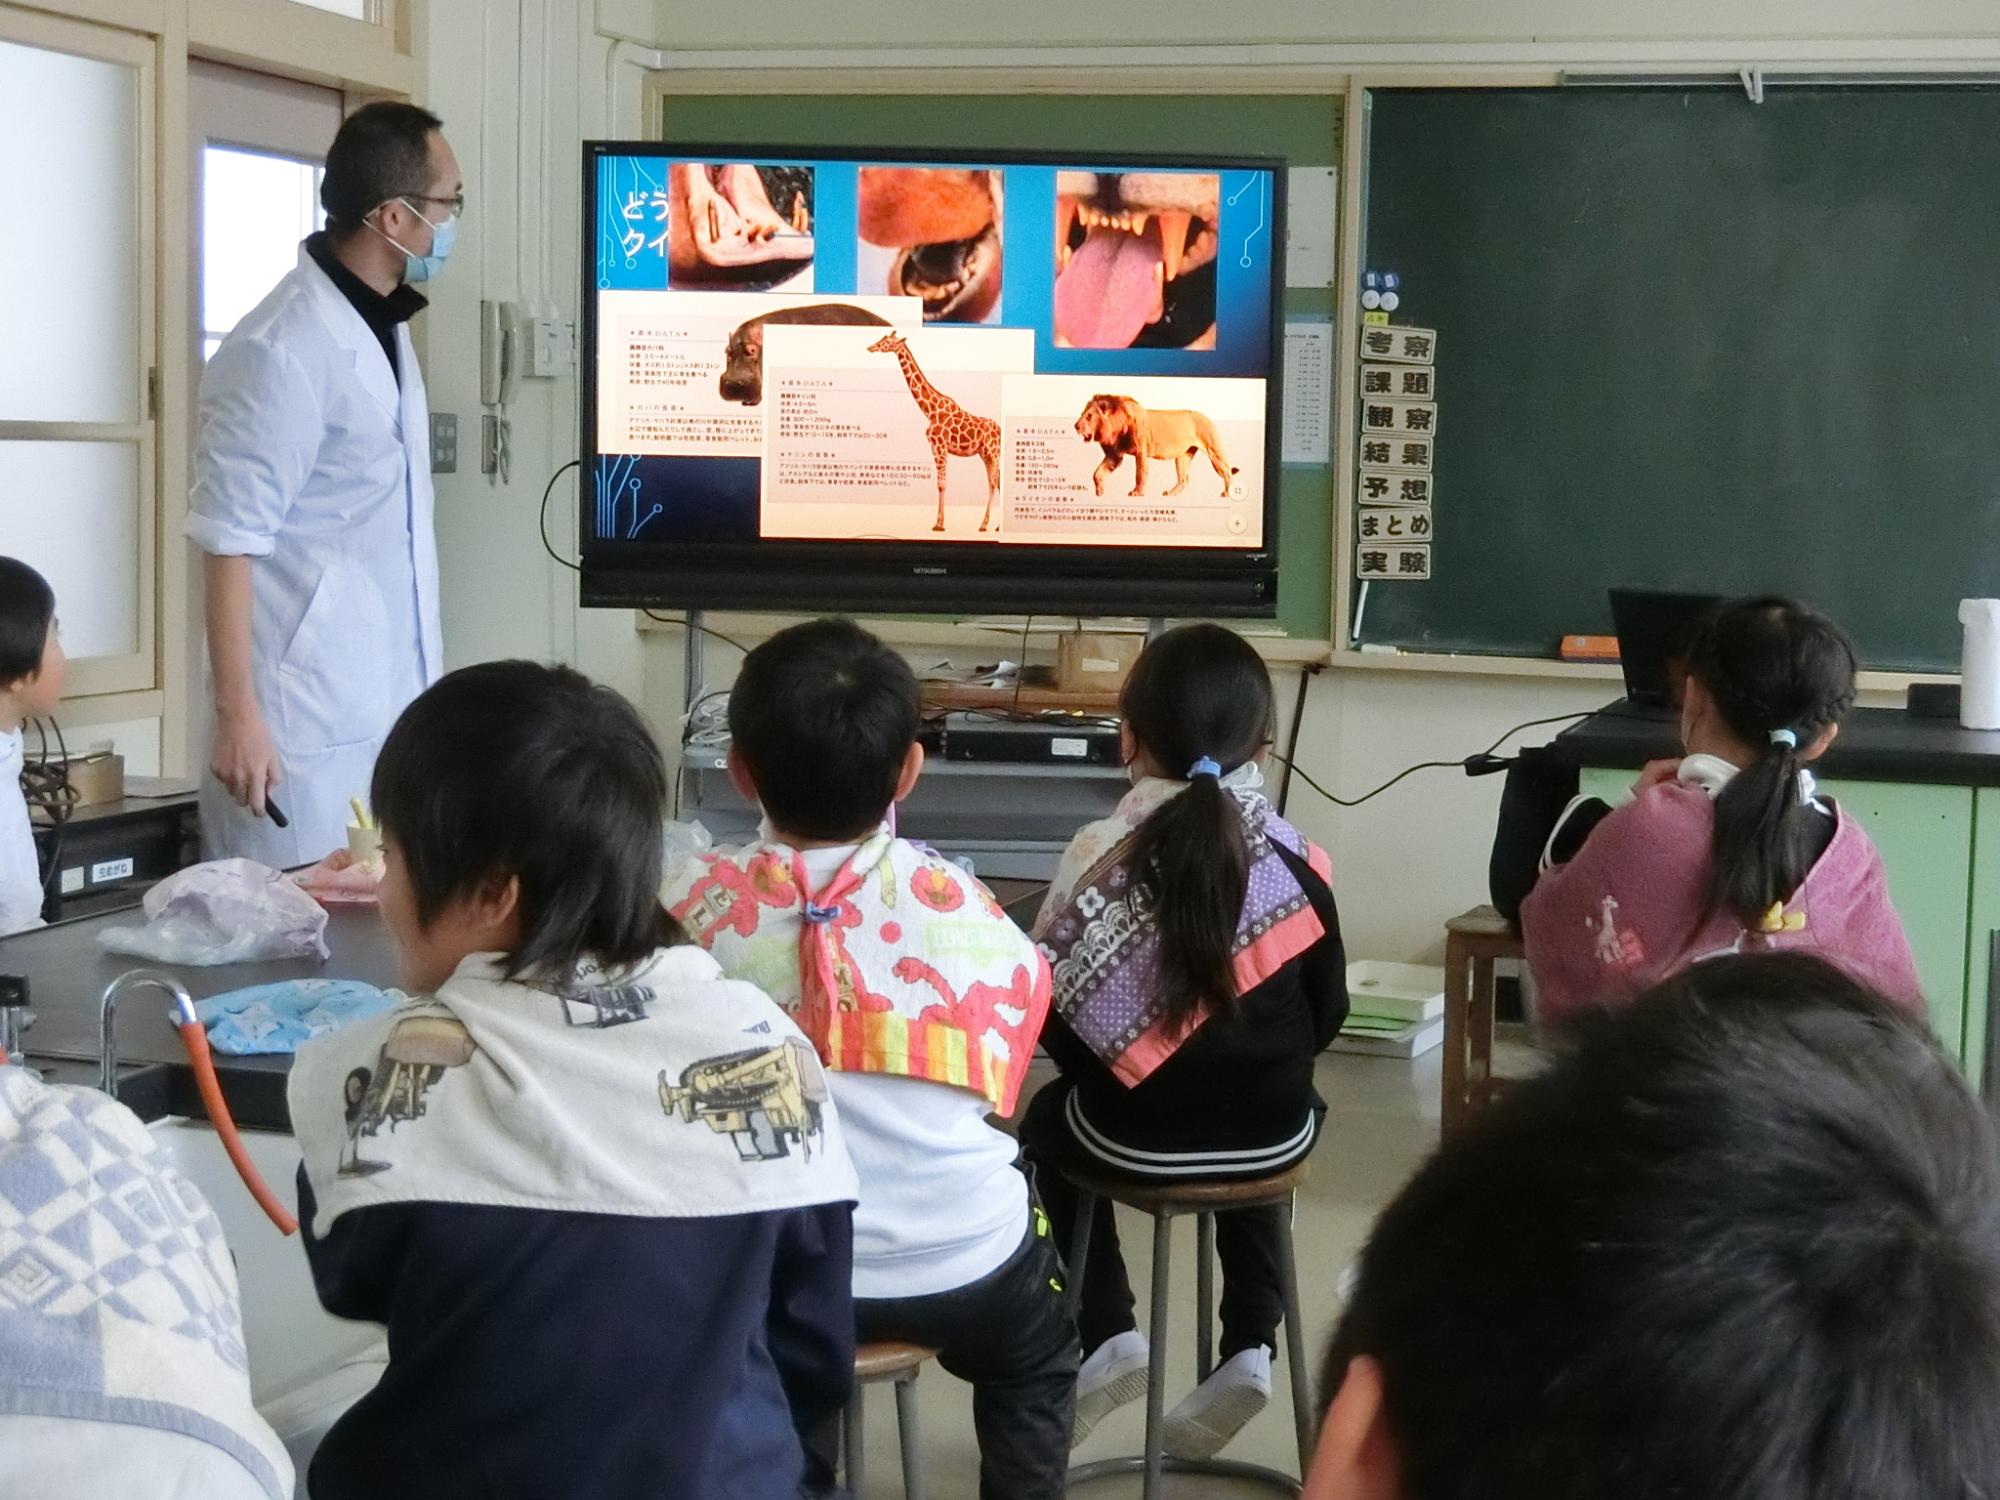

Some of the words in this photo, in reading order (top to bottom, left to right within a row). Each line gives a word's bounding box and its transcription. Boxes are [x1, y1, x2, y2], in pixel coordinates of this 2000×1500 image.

[1366, 331, 1430, 358] 考察
[1365, 371, 1428, 394] 課題
[1367, 405, 1433, 430] 観察
[1364, 441, 1427, 465] 結果
[1363, 477, 1427, 500] 予想
[1363, 514, 1429, 536] まとめ
[1361, 551, 1425, 573] 実験
